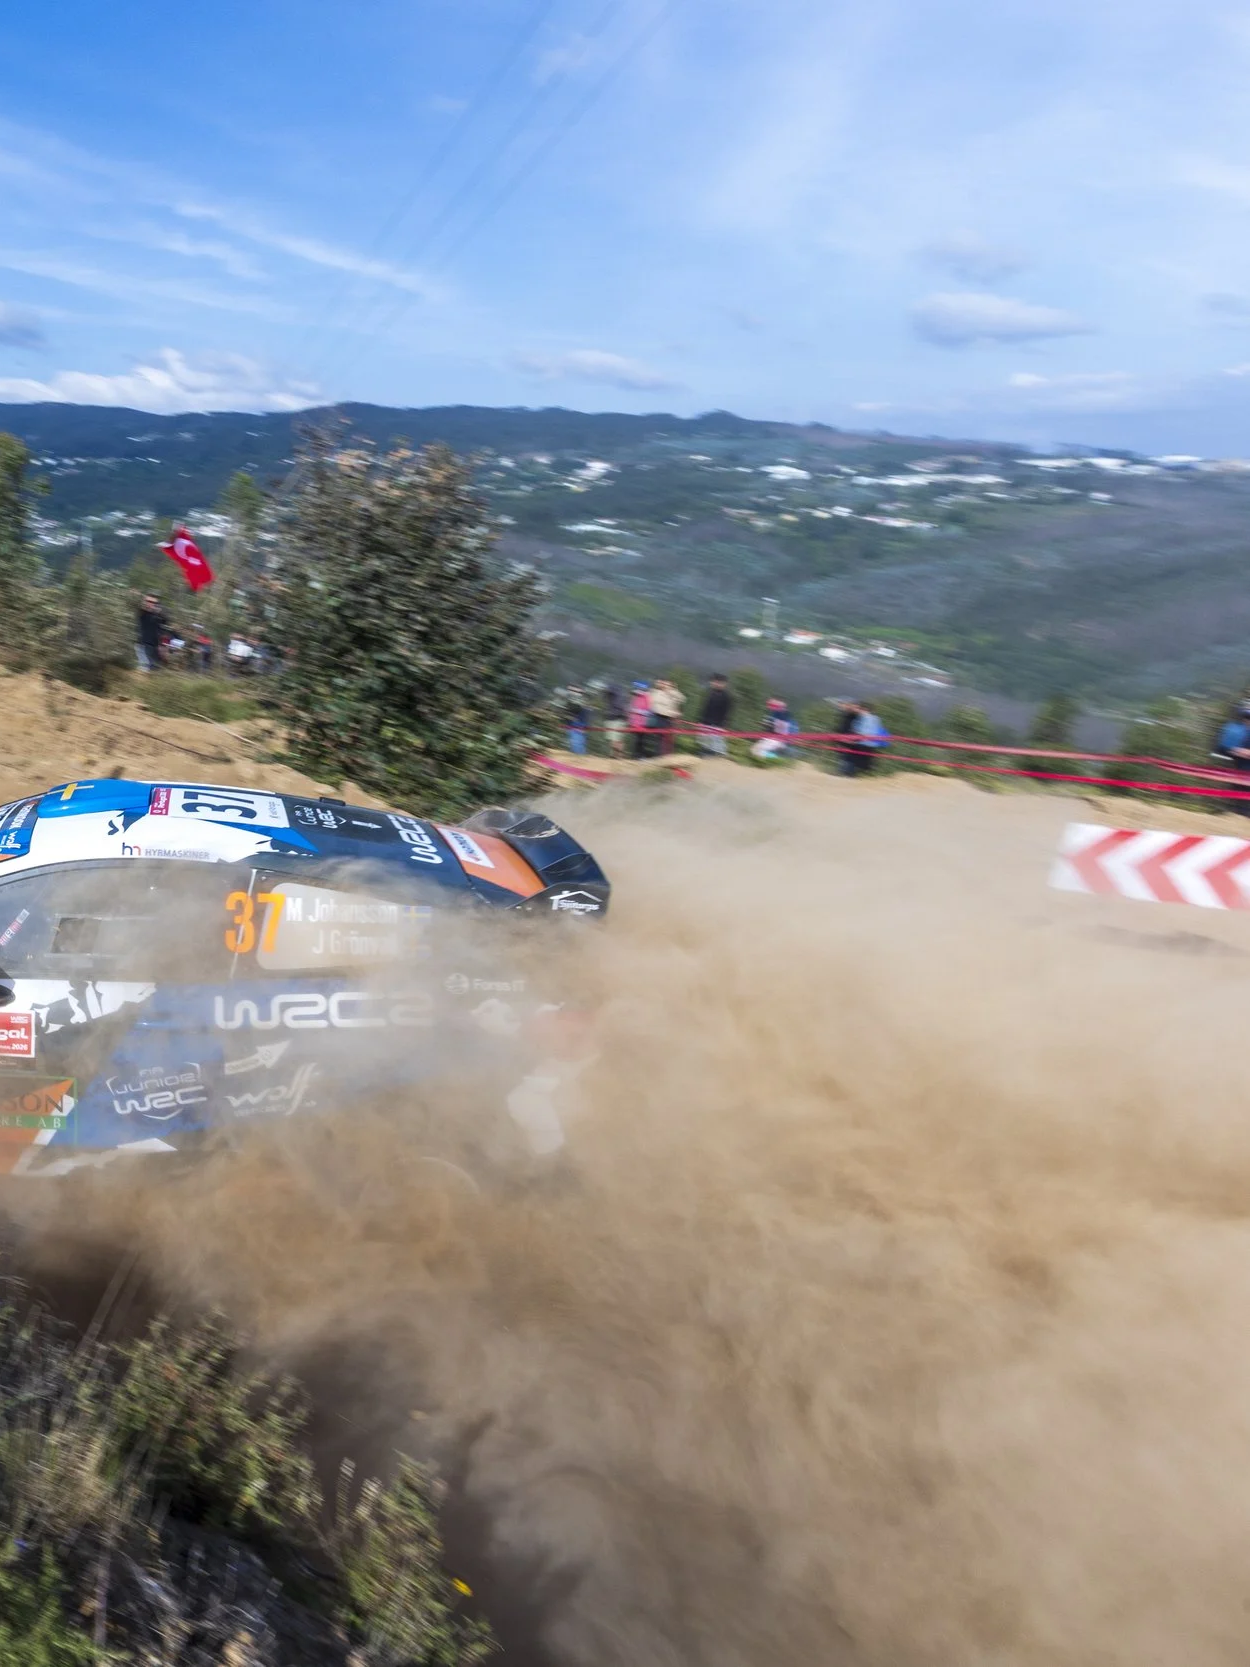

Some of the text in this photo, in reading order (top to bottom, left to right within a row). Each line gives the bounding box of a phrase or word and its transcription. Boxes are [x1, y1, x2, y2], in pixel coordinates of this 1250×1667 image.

[181, 790, 257, 819] 37
[145, 848, 210, 860] HYRMASKINER
[224, 891, 286, 954] 37
[286, 897, 302, 922] M
[312, 930, 324, 955] J
[11, 1043, 28, 1051] 2026
[113, 1086, 207, 1115] WRC
[37, 1116, 62, 1129] AB
